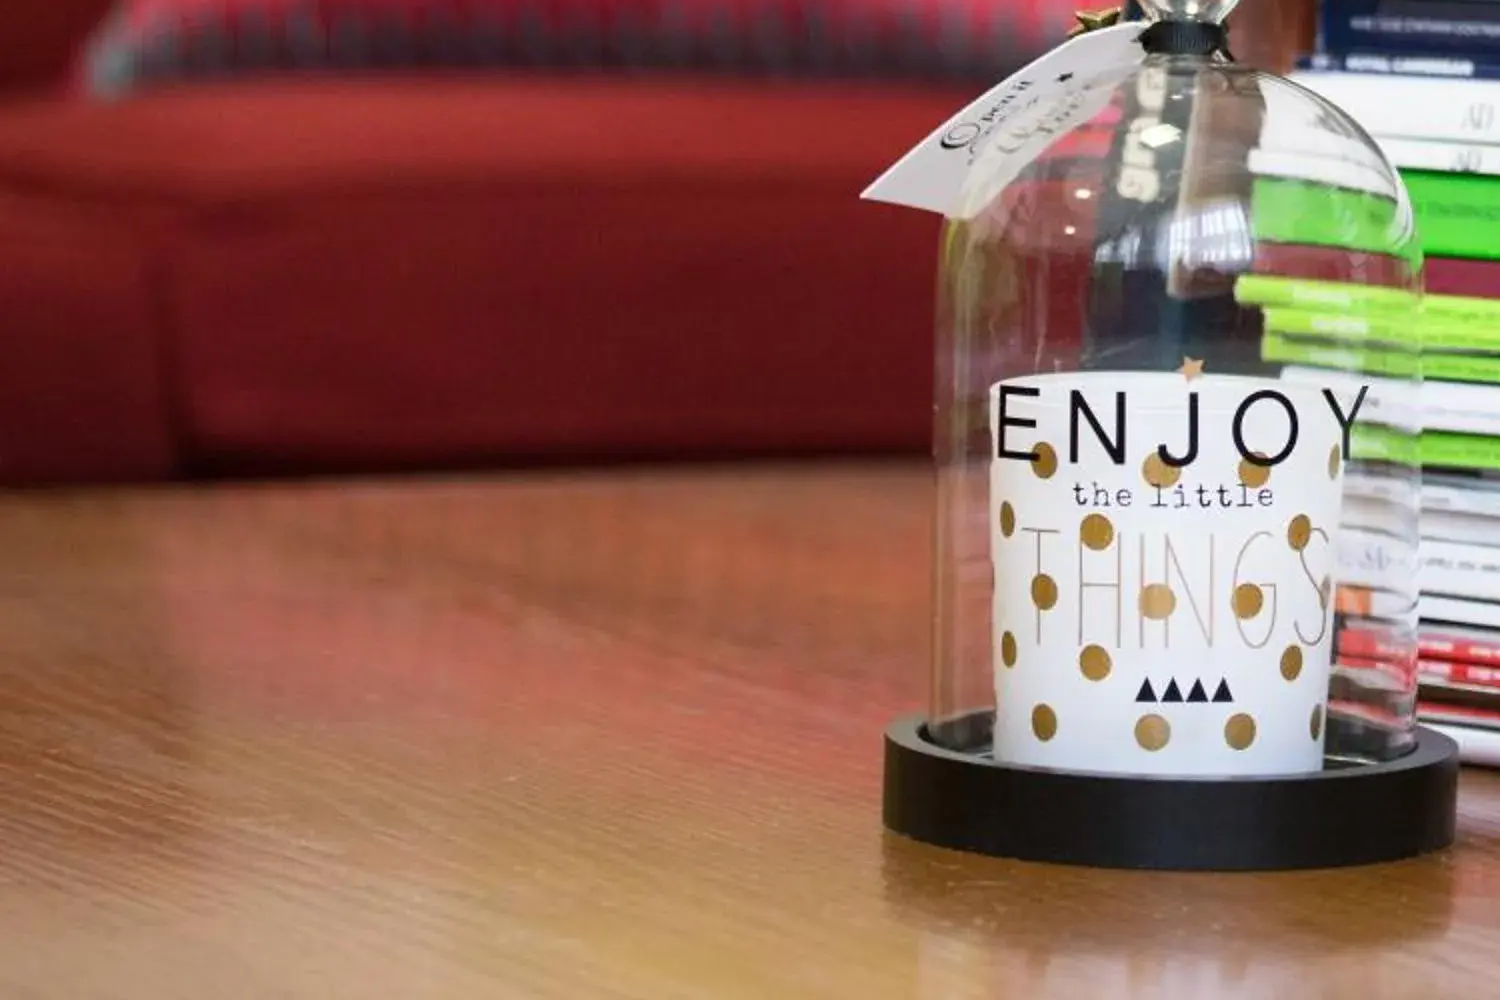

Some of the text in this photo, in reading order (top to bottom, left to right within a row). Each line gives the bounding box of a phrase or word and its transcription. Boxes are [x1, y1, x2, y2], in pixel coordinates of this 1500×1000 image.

[997, 383, 1371, 467] ENJOY
[1071, 481, 1275, 508] the little
[1021, 525, 1336, 650] THINGS
